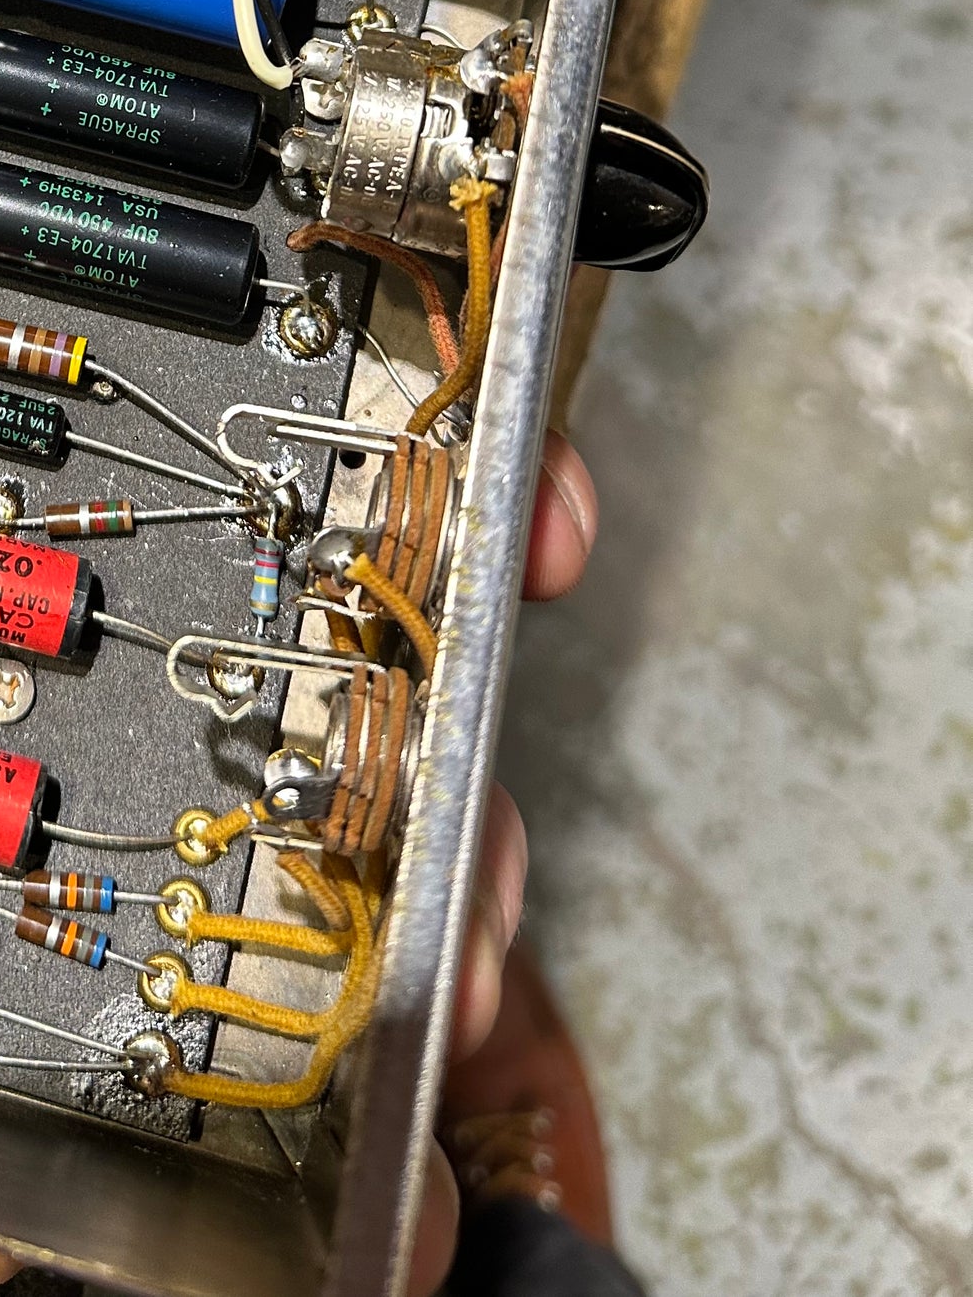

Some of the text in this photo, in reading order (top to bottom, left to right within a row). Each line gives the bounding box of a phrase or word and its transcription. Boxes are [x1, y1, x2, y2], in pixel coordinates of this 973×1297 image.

[61, 45, 176, 80] 8UF 450 VDC
[62, 58, 168, 98] TVA1704-E3
[78, 111, 161, 144] SPRAGUE
[38, 181, 105, 206] 1433H9
[122, 200, 159, 220] USA
[39, 201, 159, 245] 8UF 450 VDC
[37, 227, 148, 270] TVA1704-E3
[18, 399, 56, 415] 25UF
[30, 415, 53, 434] TVA
